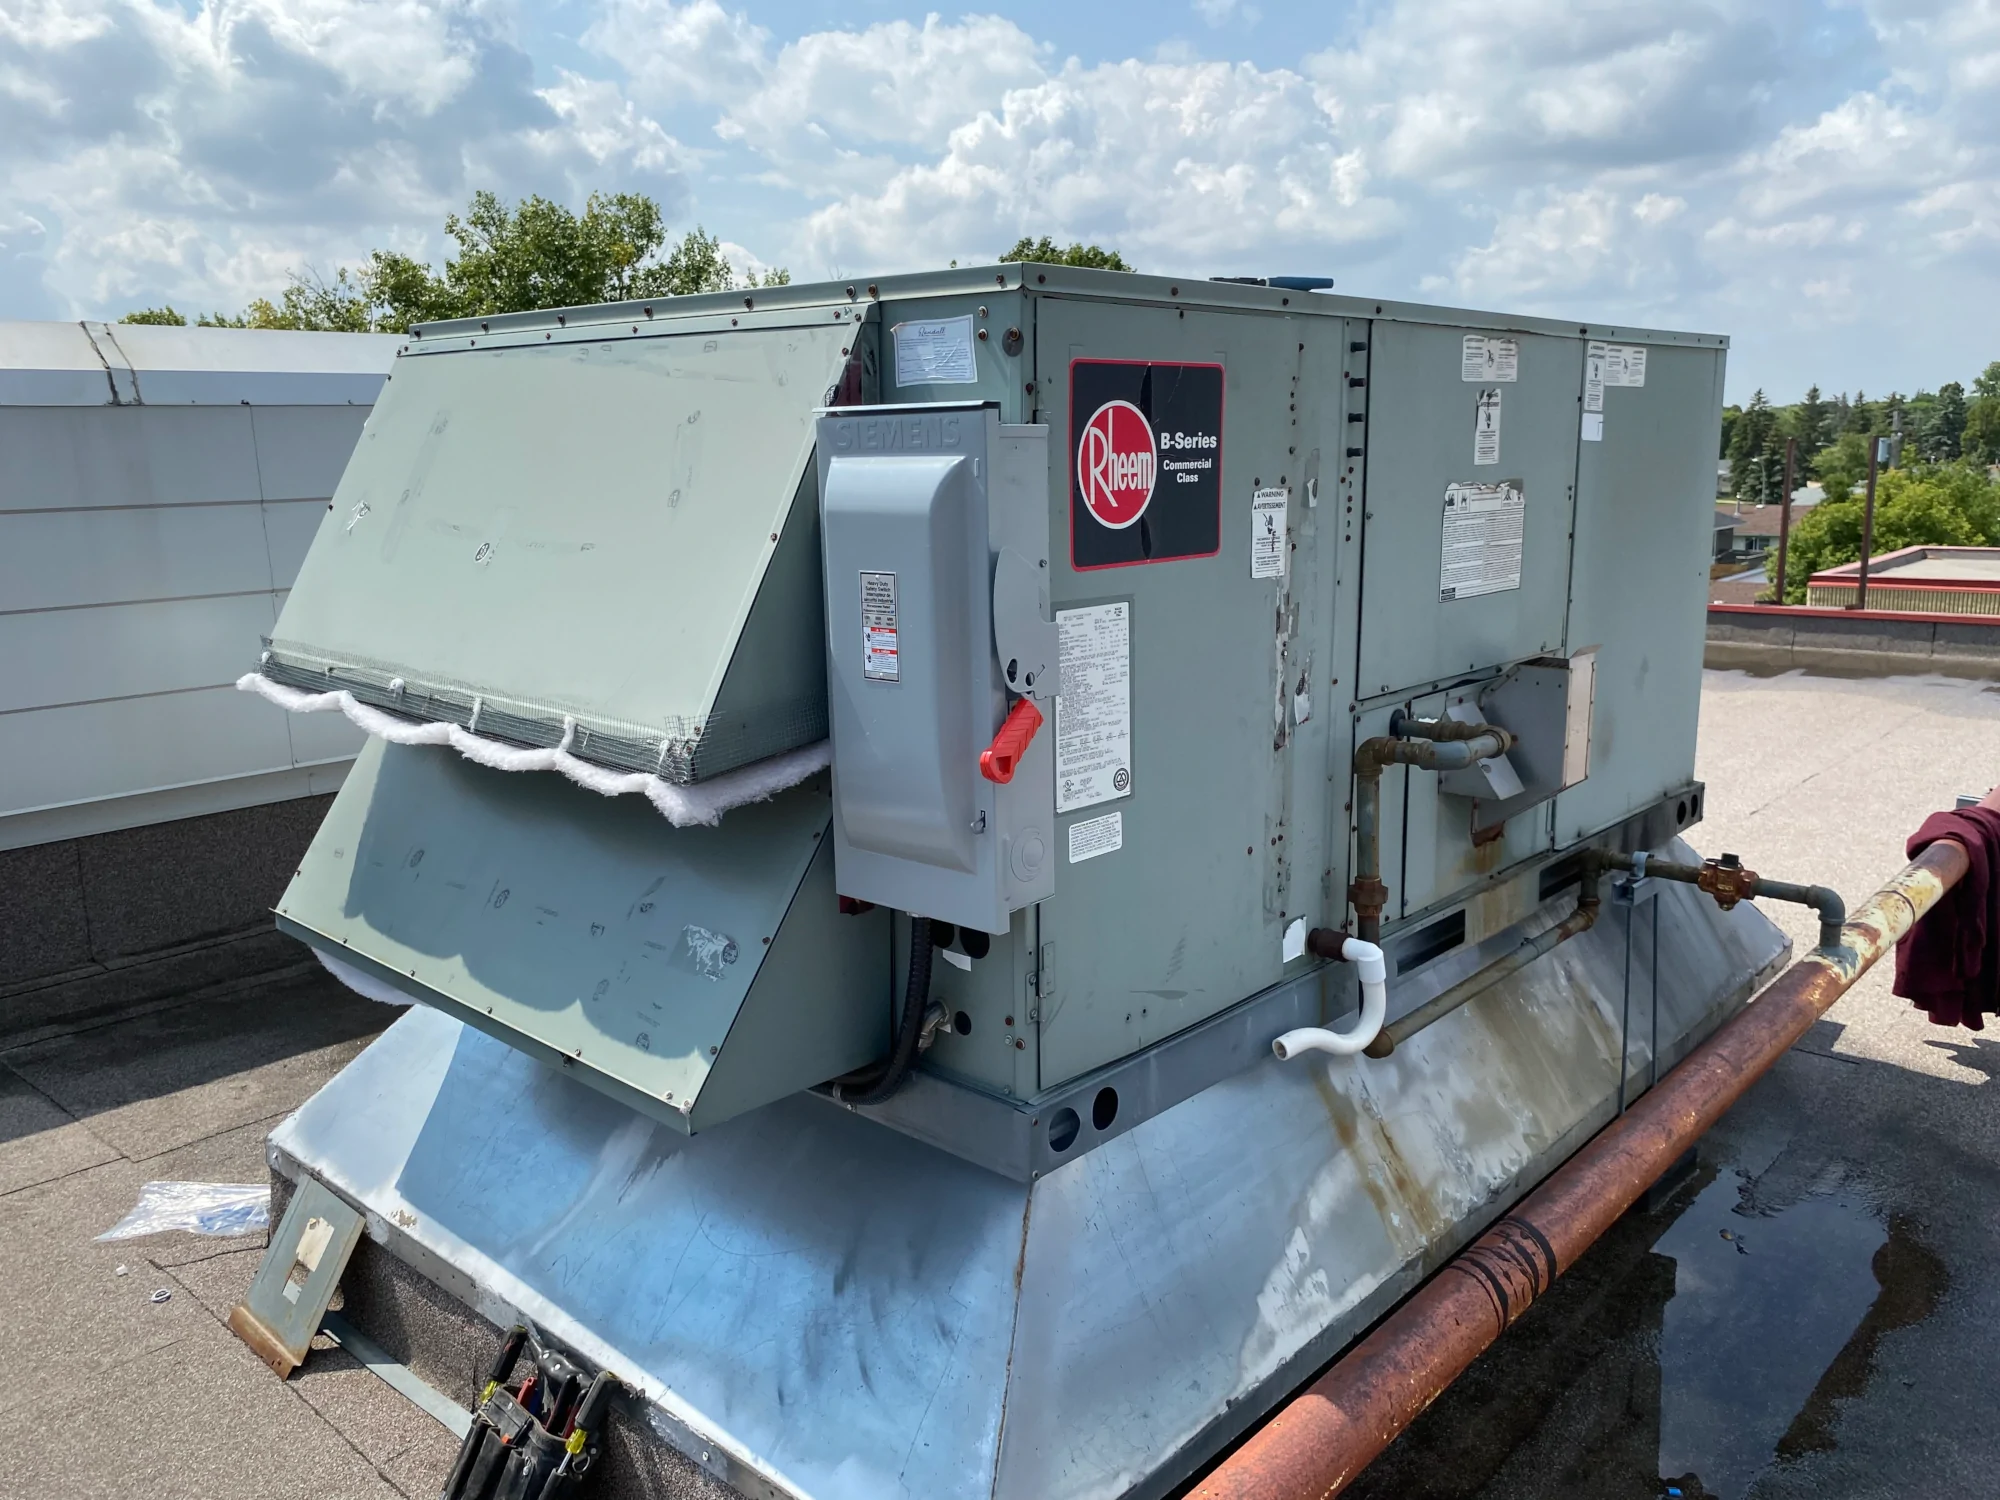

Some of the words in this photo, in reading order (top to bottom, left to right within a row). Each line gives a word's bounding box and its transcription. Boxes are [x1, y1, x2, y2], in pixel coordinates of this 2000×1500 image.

[836, 416, 962, 451] SIEMENS
[1161, 432, 1217, 449] B-Series
[1089, 408, 1152, 507] Rheem
[1163, 458, 1212, 470] Commercial
[1177, 472, 1198, 483] Class
[1261, 490, 1284, 498] WARNING
